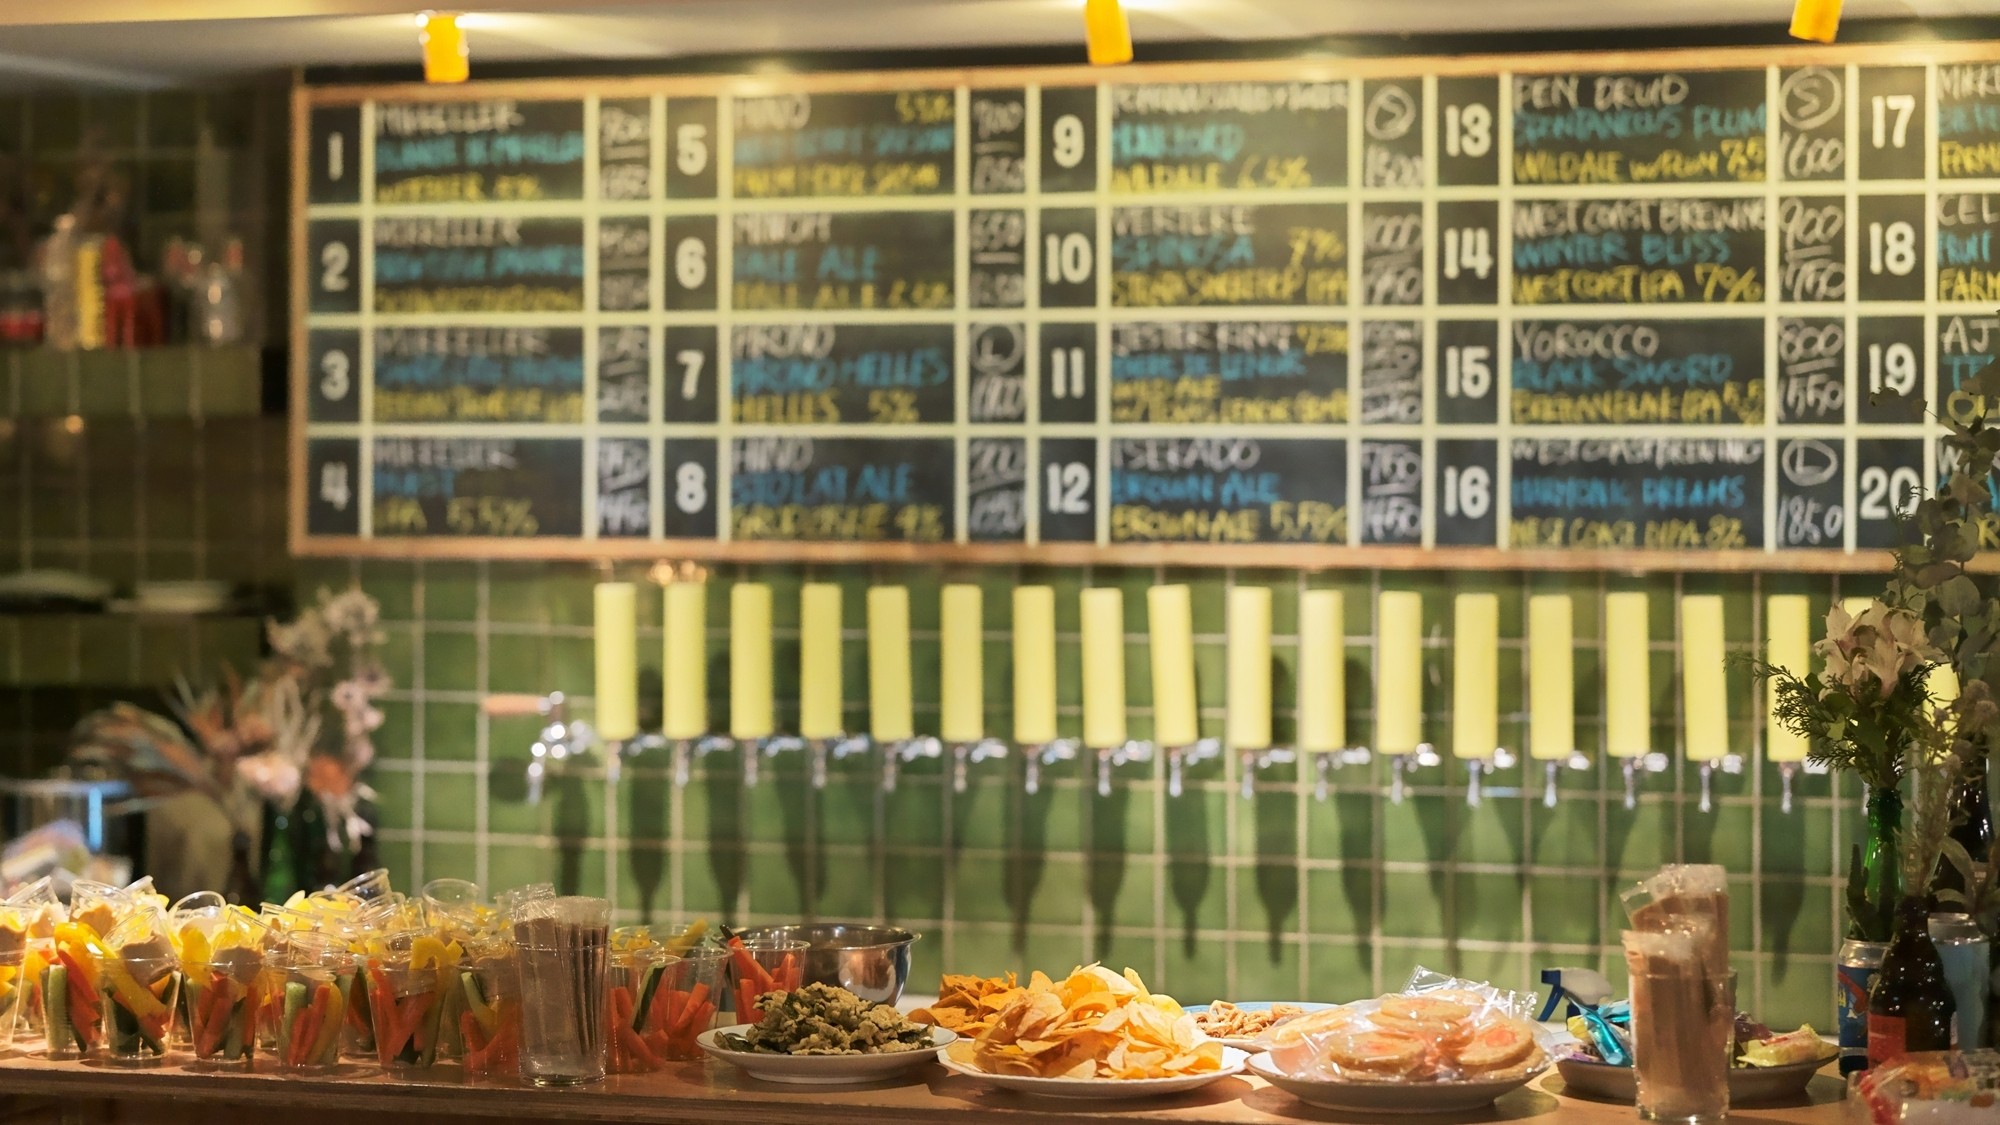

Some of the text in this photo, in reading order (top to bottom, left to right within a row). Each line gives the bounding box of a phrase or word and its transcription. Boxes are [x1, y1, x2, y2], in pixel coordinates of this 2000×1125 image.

[1513, 75, 1578, 111] PEN
[1053, 114, 1085, 168] 9
[1445, 102, 1493, 157] 13
[1872, 94, 1916, 149] 17
[327, 131, 344, 182] 1
[677, 123, 707, 175] 5
[321, 240, 349, 292] 2
[676, 236, 706, 290] 6
[1046, 232, 1093, 285] 10
[1444, 226, 1493, 280] 14
[1868, 221, 1917, 276] 18
[321, 349, 349, 401] 3
[676, 349, 704, 400] 7
[1050, 346, 1086, 400] 11
[1445, 344, 1492, 400] 15
[1868, 341, 1917, 398] 19
[320, 461, 350, 512] 4
[676, 461, 707, 514] 8
[1047, 461, 1091, 514] 12
[1443, 464, 1491, 519] 16
[1859, 465, 1921, 520] 20
